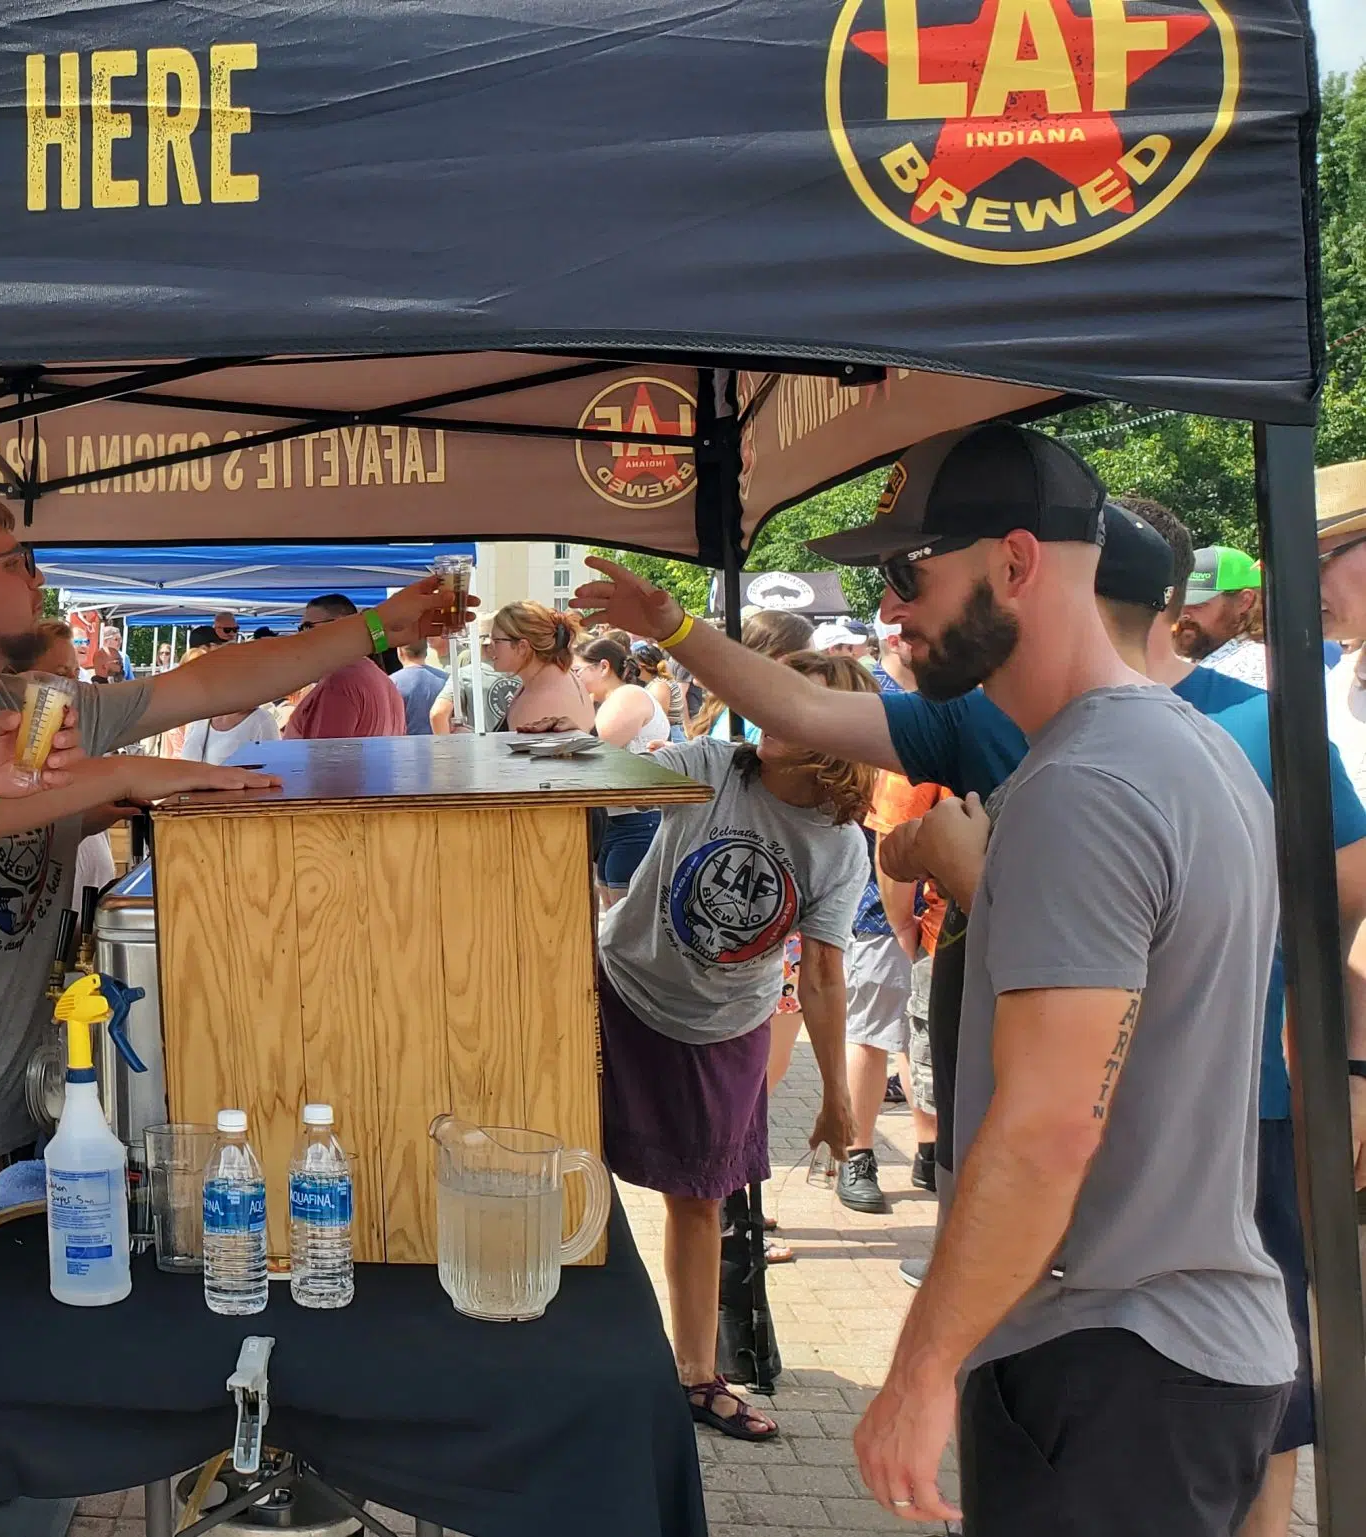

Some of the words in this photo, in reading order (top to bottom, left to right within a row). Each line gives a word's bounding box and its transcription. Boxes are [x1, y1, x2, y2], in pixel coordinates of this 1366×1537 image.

[26, 43, 261, 212] HERE
[965, 127, 1087, 149] INDIANA
[879, 134, 1172, 233] BREWED
[766, 840, 786, 856] 30
[712, 853, 776, 904] LAF
[701, 886, 735, 923] BREW
[1092, 988, 1142, 1120] ARTIN
